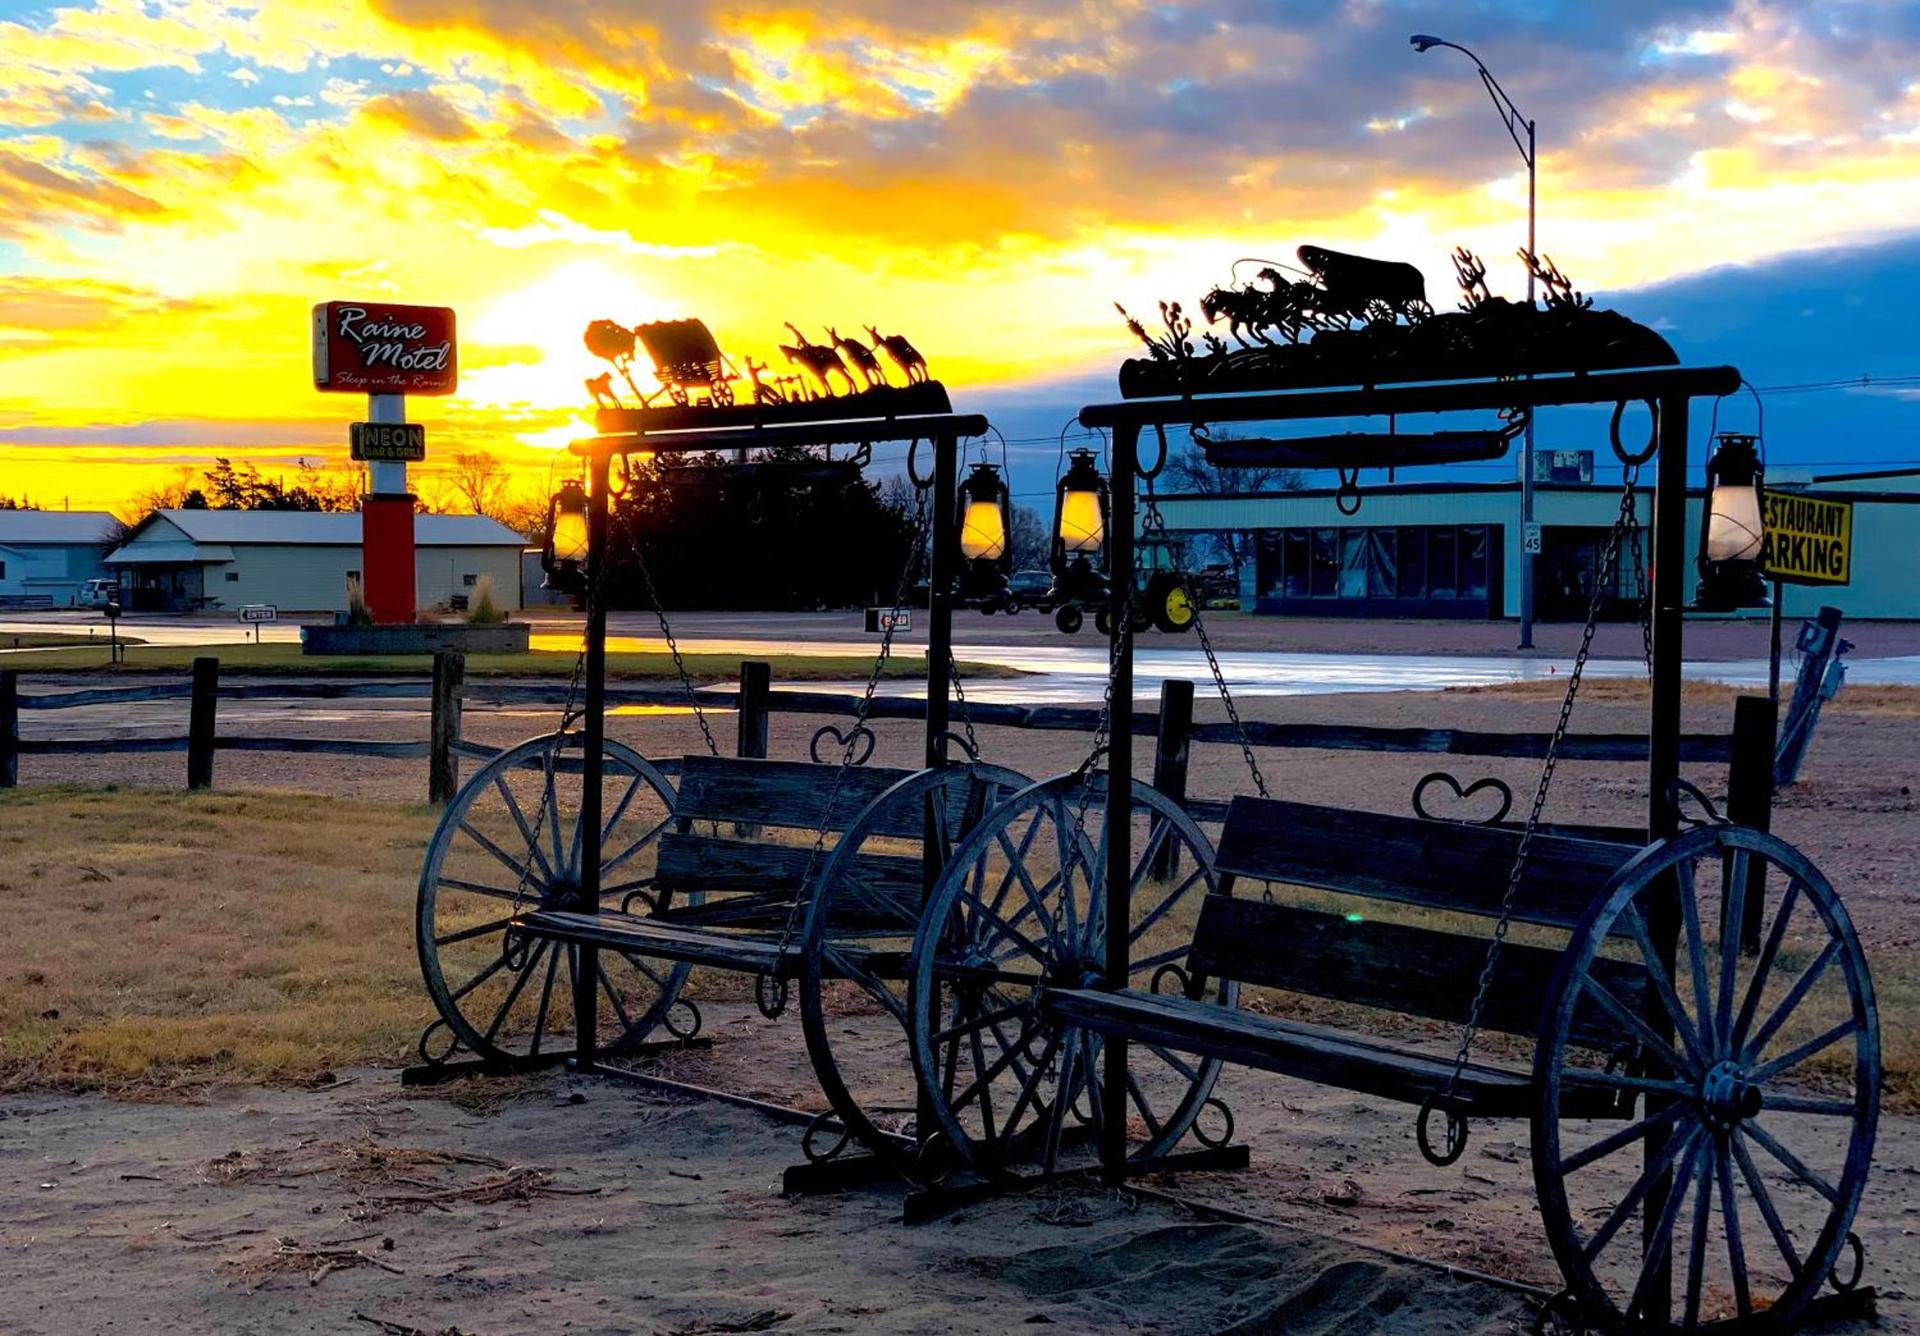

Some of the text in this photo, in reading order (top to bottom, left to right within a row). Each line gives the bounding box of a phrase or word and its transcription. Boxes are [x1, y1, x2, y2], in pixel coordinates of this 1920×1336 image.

[339, 307, 426, 343] Raine
[362, 342, 450, 370] Motel
[336, 371, 367, 388] Sleep
[387, 375, 407, 386] the
[365, 428, 422, 447] NEON
[1761, 495, 1844, 537] ESTAURANT
[1526, 538, 1539, 550] 45
[1763, 531, 1843, 576] ARKING
